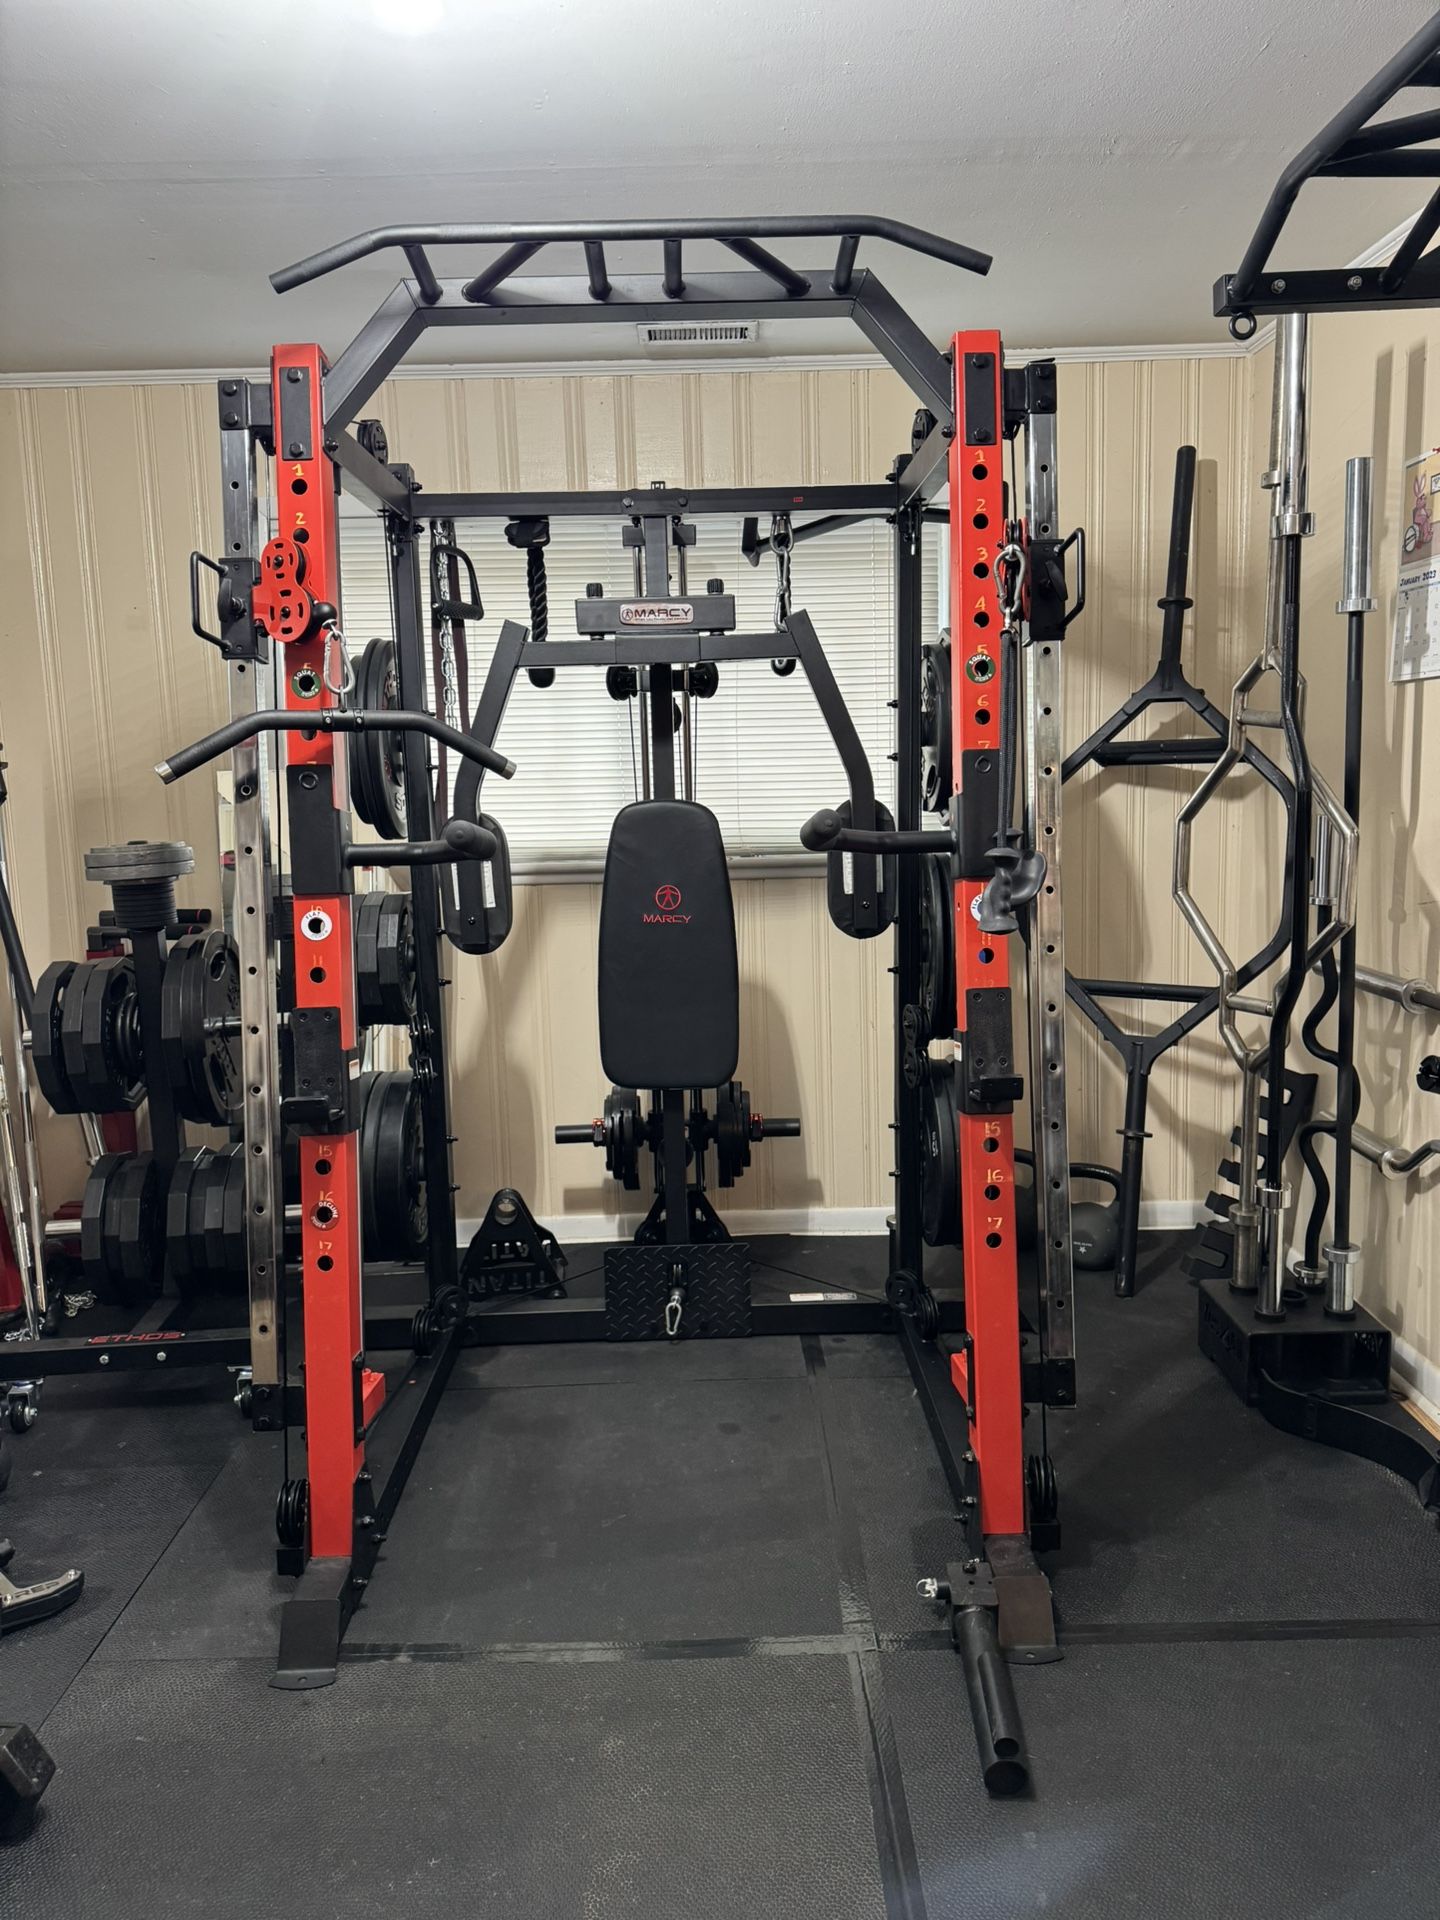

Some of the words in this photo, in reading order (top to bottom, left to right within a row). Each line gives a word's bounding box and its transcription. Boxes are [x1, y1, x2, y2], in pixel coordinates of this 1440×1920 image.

[974, 450, 986, 462] 1
[291, 464, 304, 476] 1
[975, 499, 987, 512] 2
[295, 512, 306, 525] 2
[976, 547, 988, 561] 3
[1422, 569, 1437, 582] 2023
[974, 595, 987, 610] 4
[634, 607, 691, 618] MARCY
[968, 654, 991, 665] SQUAT
[293, 669, 316, 681] SQUAT
[976, 694, 990, 707] 6
[305, 911, 320, 920] FLAT
[643, 913, 692, 924] MARCY
[313, 954, 323, 966] 11
[984, 1121, 1001, 1137] 15
[319, 1144, 333, 1157] 15
[987, 1168, 1004, 1184] 16
[318, 1201, 339, 1219] DECLINE
[318, 1240, 333, 1252] 17
[90, 1331, 183, 1345] ETHOS
